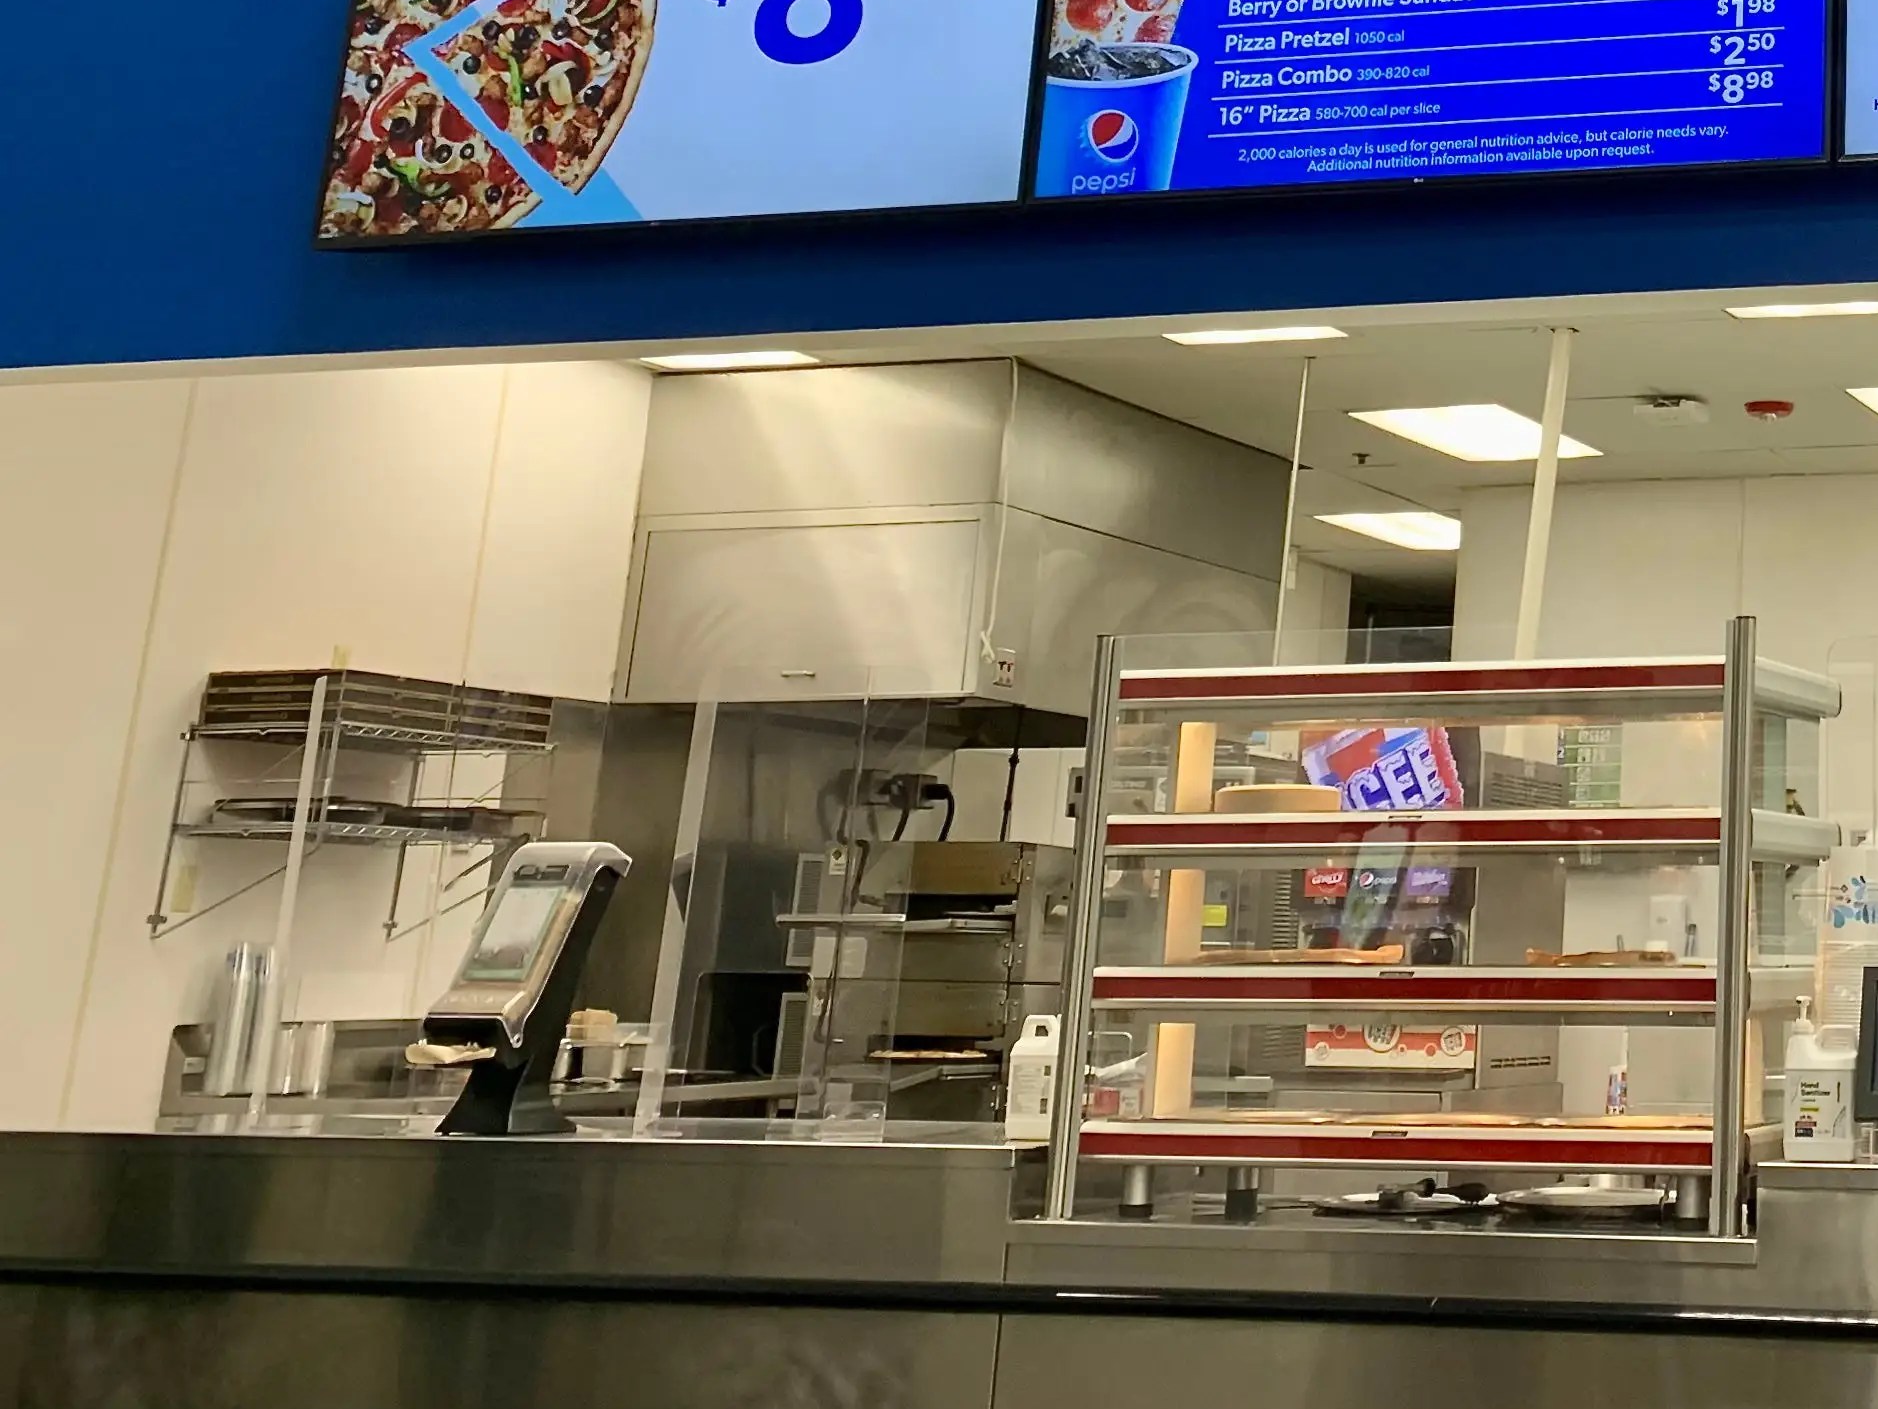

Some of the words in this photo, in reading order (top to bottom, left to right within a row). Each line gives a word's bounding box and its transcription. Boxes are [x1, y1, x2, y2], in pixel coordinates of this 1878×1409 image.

[1286, 0, 1308, 12] or
[1225, 32, 1276, 52] Pizza
[1280, 28, 1350, 49] Pretzel
[1354, 30, 1385, 44] 1050
[1387, 29, 1405, 42] cal
[1222, 68, 1273, 89] Pizza
[1278, 64, 1352, 85] Combo
[1357, 66, 1410, 81] 390-820
[1412, 64, 1430, 77] cal
[1259, 102, 1310, 123] Pizza
[1315, 105, 1368, 120] 580-700
[1370, 103, 1387, 116] cal
[1389, 104, 1410, 118] per
[1412, 100, 1441, 115] slice
[1238, 147, 1276, 163] 2,000
[1278, 146, 1327, 159] calories
[1328, 148, 1336, 157] a
[1339, 143, 1363, 158] day
[1364, 142, 1374, 154] is
[1376, 140, 1407, 154] used
[1409, 139, 1428, 152] for
[1430, 136, 1478, 154] general
[1481, 133, 1534, 147] nutrition
[1536, 131, 1583, 145] advice,
[1585, 129, 1608, 142] but
[1610, 127, 1655, 141] calorie
[1656, 124, 1697, 138] needs
[1698, 125, 1729, 140] vary.
[1306, 157, 1373, 172] Additional
[1375, 154, 1428, 169] nutrition
[1430, 149, 1504, 165] information
[1505, 147, 1563, 161] available
[1565, 145, 1599, 160] upon
[1601, 143, 1655, 158] request.
[1072, 167, 1136, 194] pepsi
